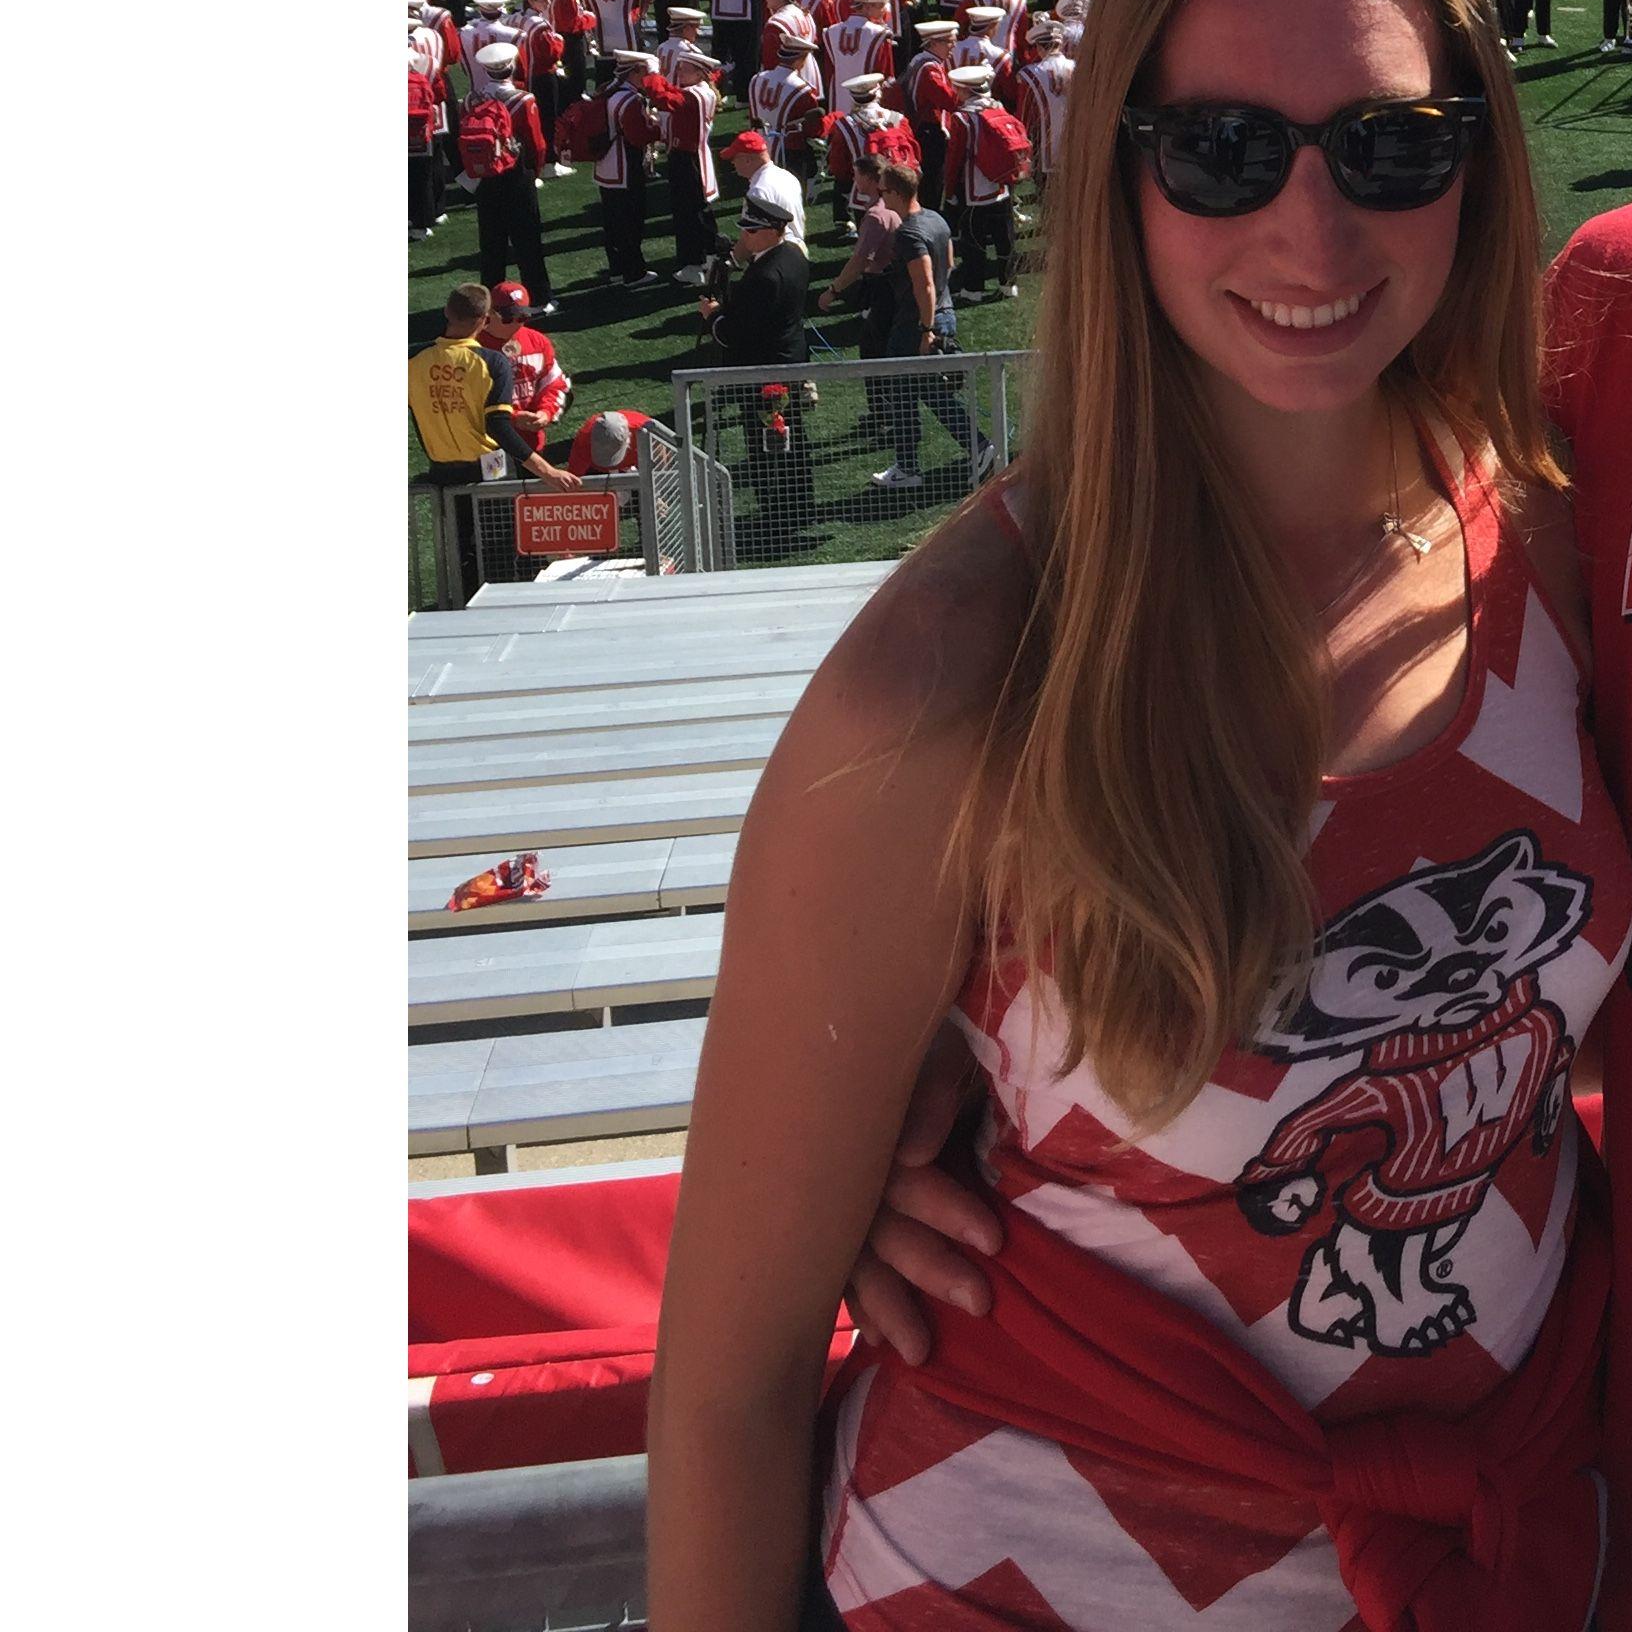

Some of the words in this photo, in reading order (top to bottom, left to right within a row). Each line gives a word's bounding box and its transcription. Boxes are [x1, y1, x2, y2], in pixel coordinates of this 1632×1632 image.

[838, 26, 864, 58] W
[759, 79, 784, 112] W
[429, 364, 466, 382] CSC
[429, 384, 465, 401] EVENT
[431, 399, 468, 414] STAFF
[523, 503, 610, 523] EMERGENCY
[531, 524, 564, 542] EXIT
[567, 523, 604, 542] ONLY
[1437, 1032, 1533, 1158] W
